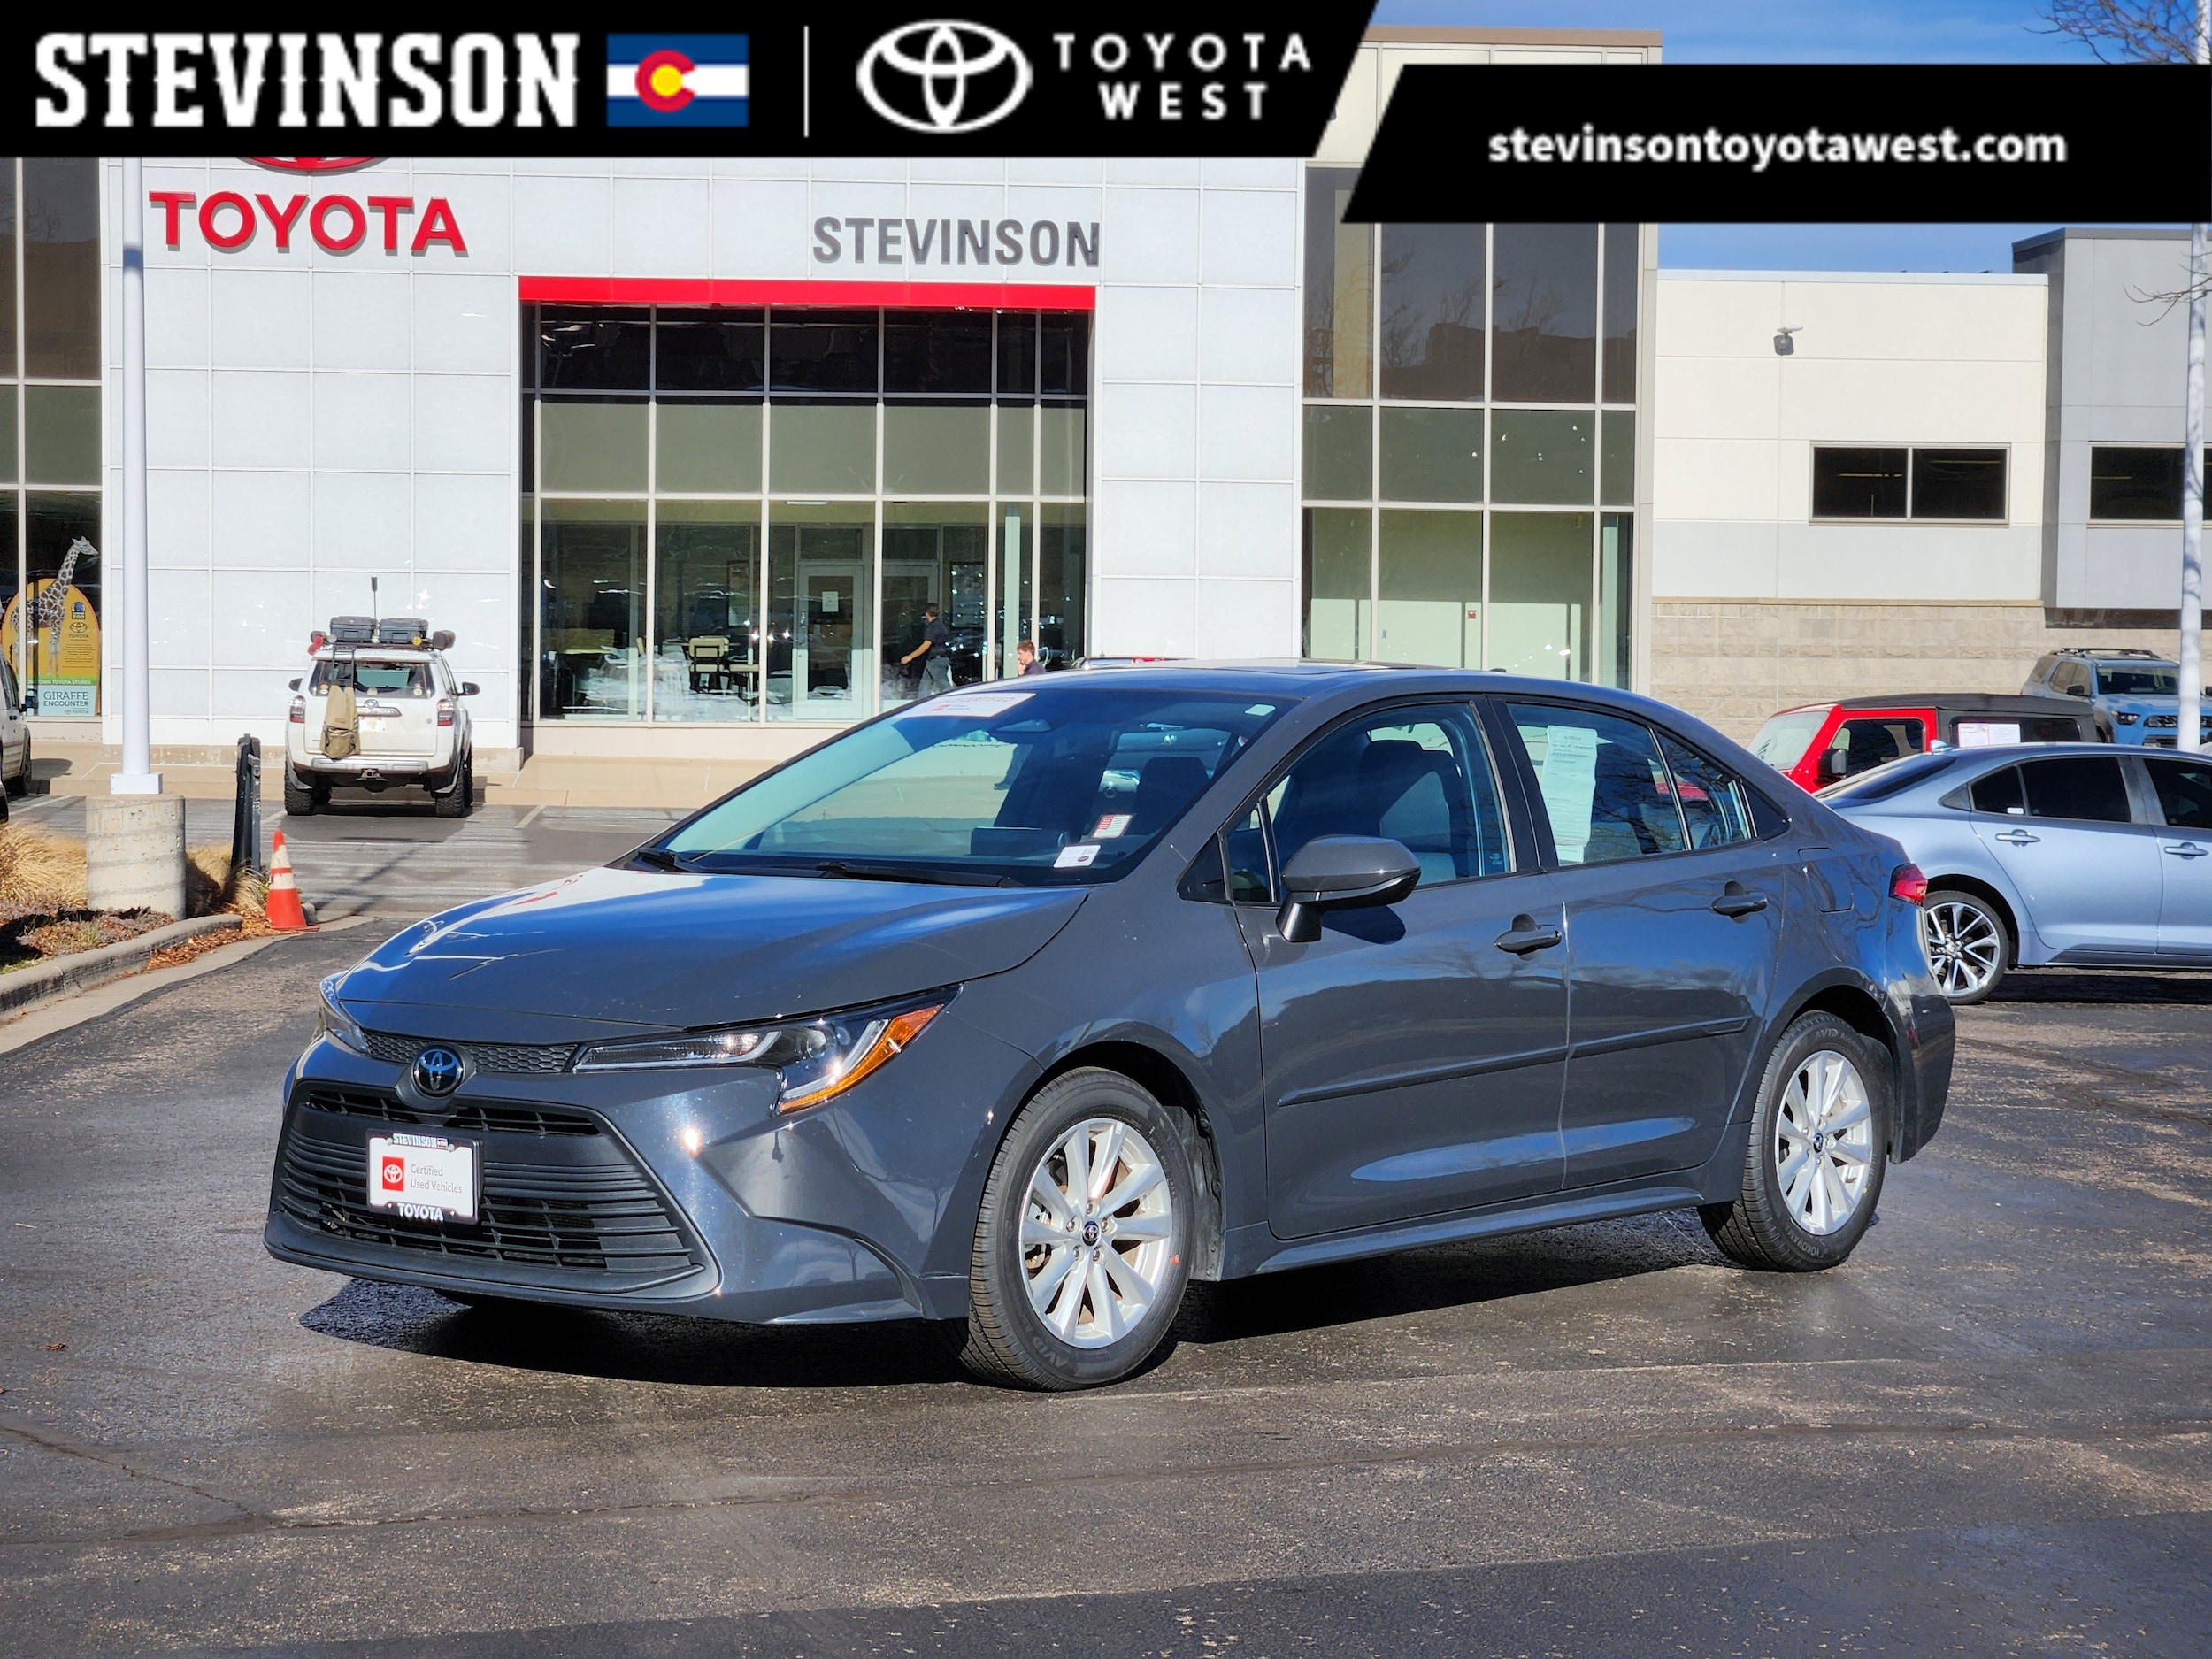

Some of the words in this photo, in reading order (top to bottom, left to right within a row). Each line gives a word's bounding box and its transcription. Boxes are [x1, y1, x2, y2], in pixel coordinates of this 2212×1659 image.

[149, 191, 466, 255] TOYOTA
[813, 216, 1100, 267] STEVINSON
[43, 691, 89, 701] GIRAFFE
[1816, 1028, 1839, 1040] AVID
[392, 1133, 437, 1148] STEVINSON
[411, 1164, 443, 1177] Certified
[411, 1178, 429, 1190] Used
[430, 1180, 463, 1194] Vehicles
[397, 1202, 444, 1222] TOYOTA
